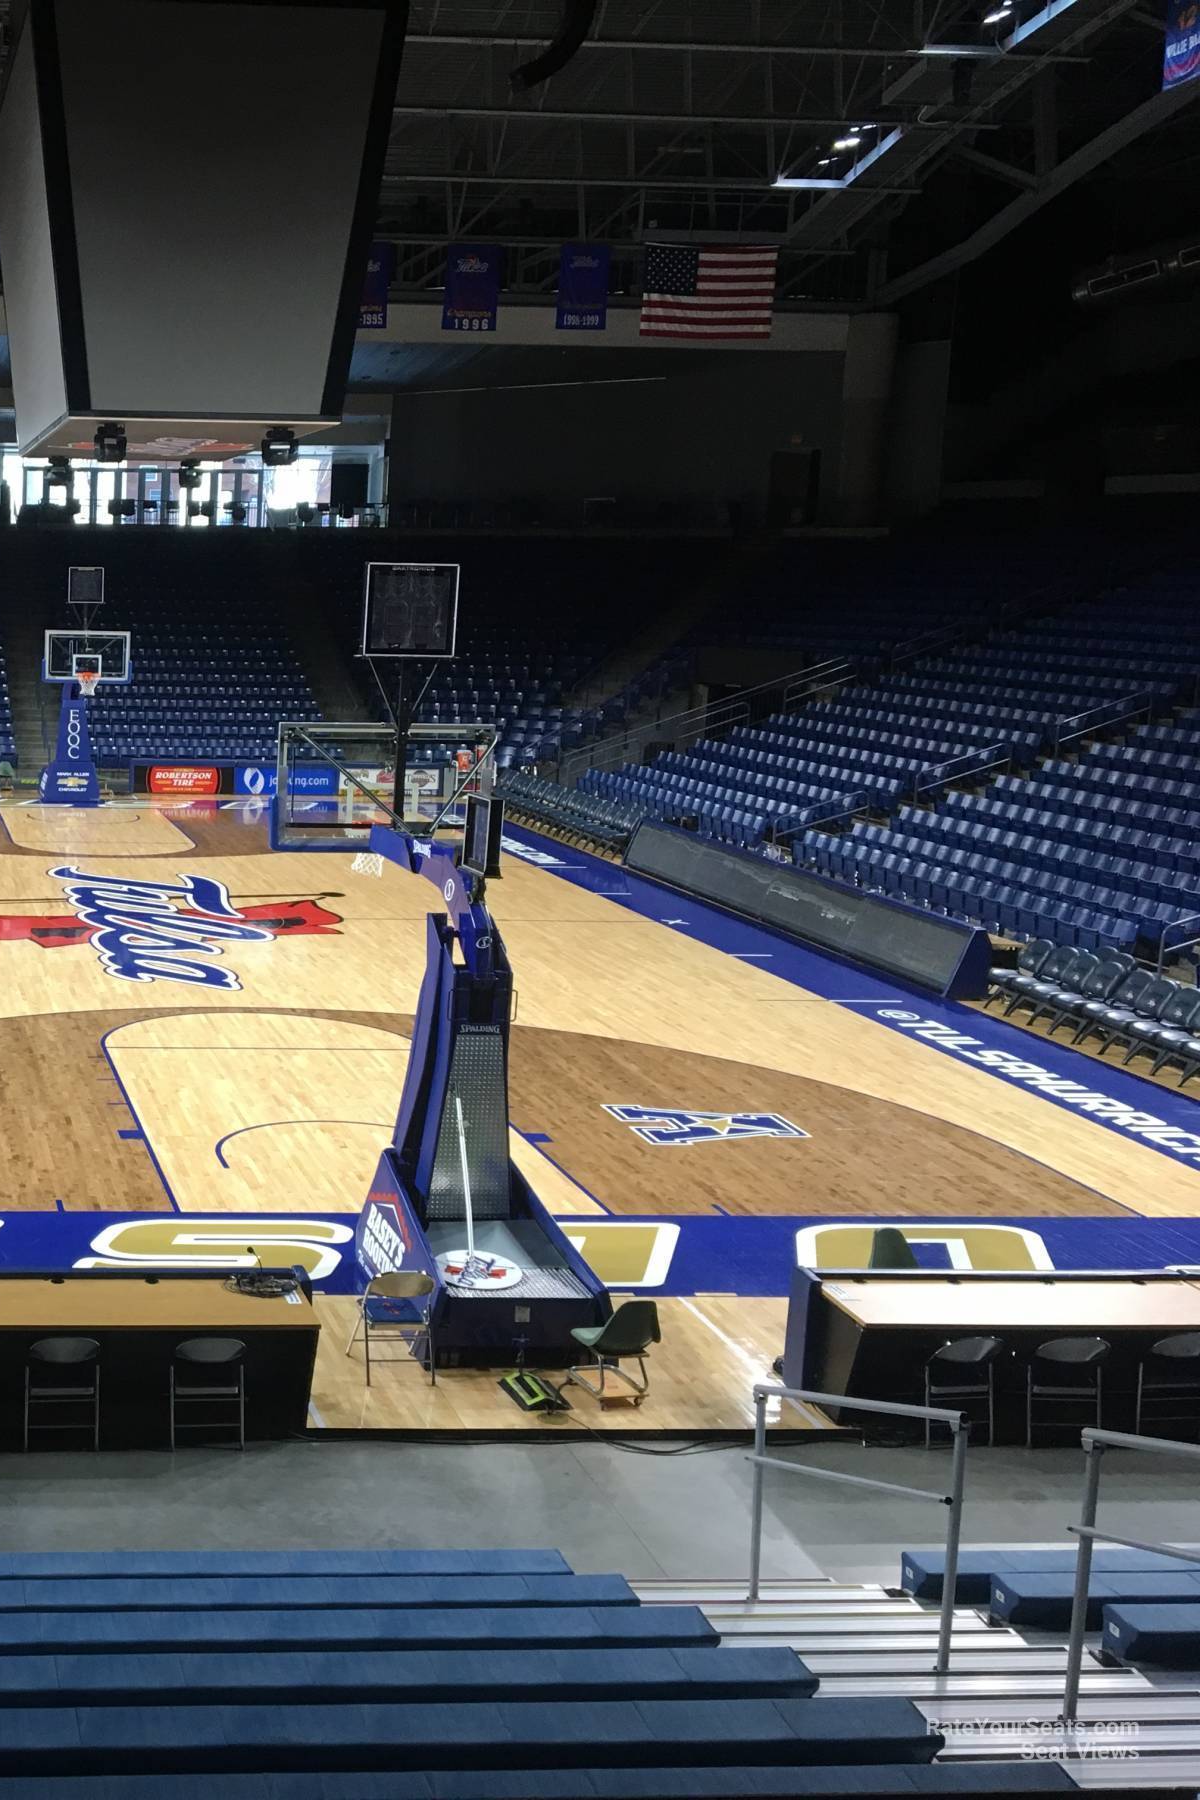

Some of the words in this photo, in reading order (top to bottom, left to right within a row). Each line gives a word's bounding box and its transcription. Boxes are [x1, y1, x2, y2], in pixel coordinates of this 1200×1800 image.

[454, 317, 489, 330] 1996
[155, 771, 212, 779] ROBERTSON
[460, 1024, 500, 1033] SPALDING
[366, 1202, 406, 1268] BASEY'S
